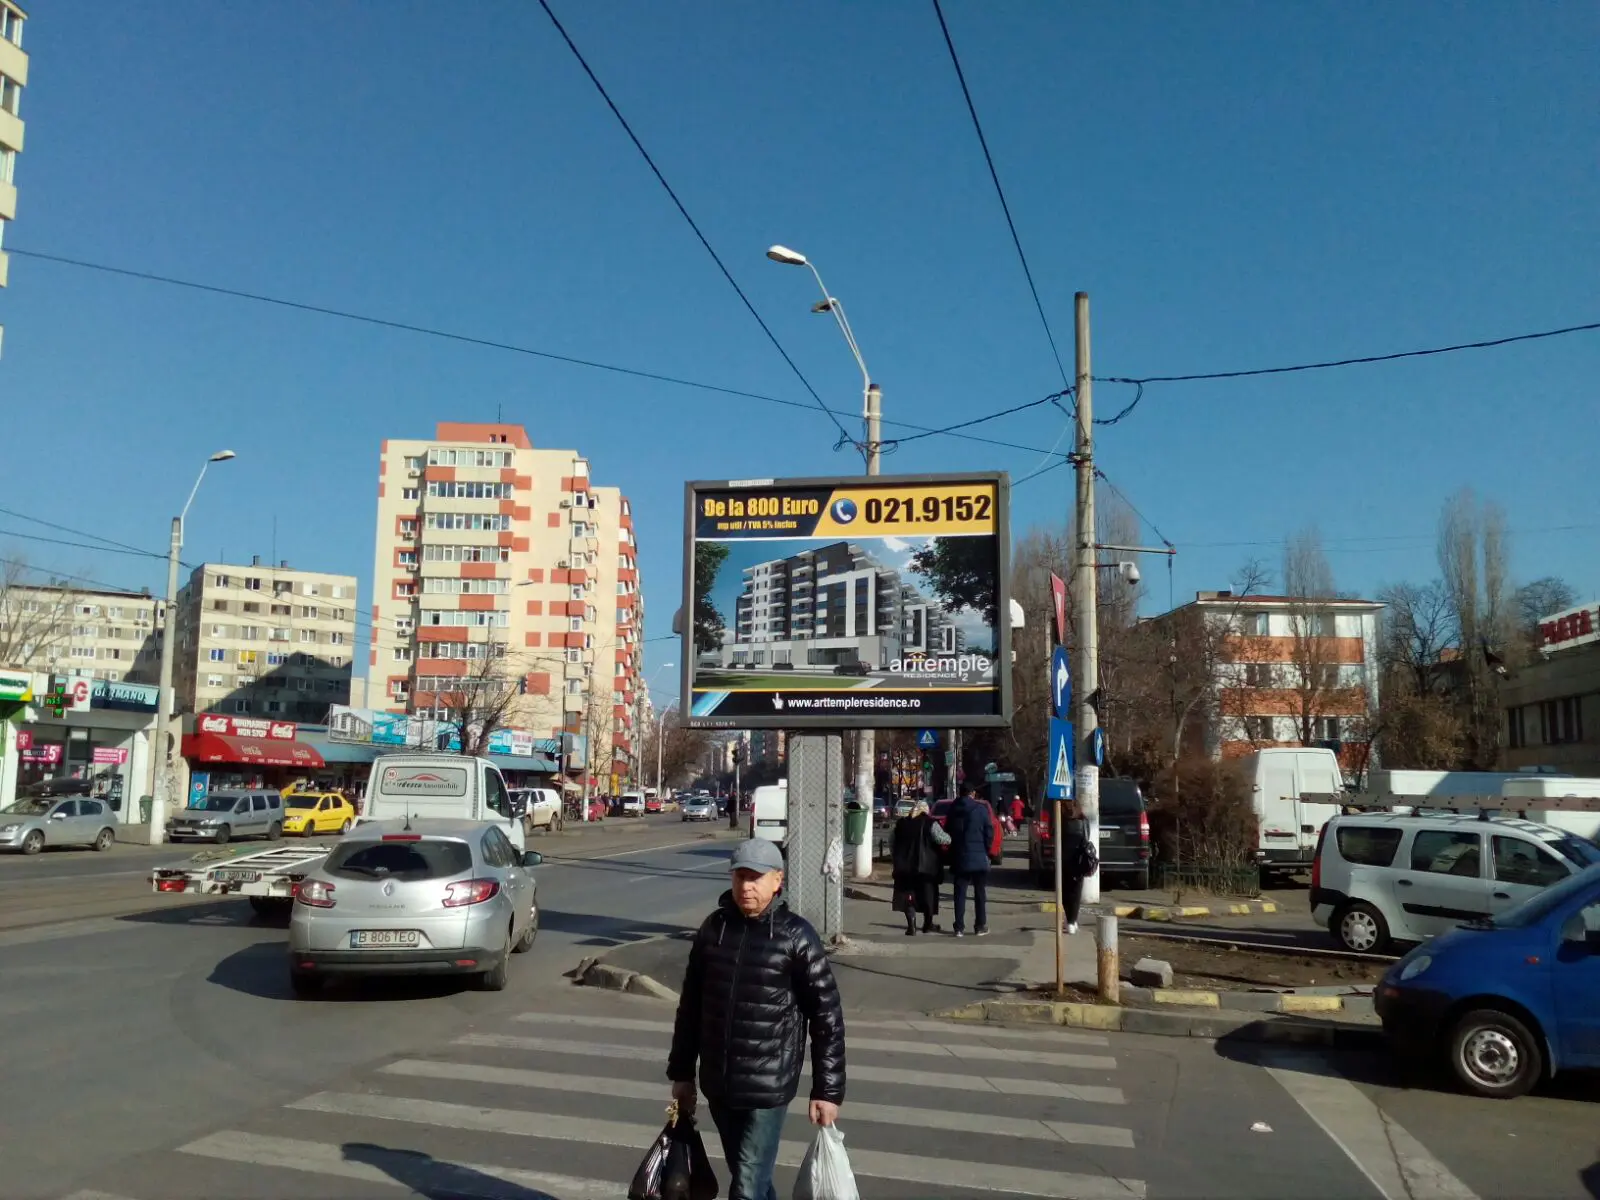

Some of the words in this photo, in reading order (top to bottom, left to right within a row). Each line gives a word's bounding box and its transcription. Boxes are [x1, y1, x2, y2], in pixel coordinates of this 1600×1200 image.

[704, 498, 726, 517] De
[728, 498, 745, 517] la
[747, 497, 779, 516] 800
[782, 496, 819, 516] Euro
[865, 494, 991, 524] 021.9152
[748, 520, 762, 530] TVA
[890, 652, 990, 677] arttemple
[961, 674, 969, 682] 2
[788, 697, 921, 709] www.arttempleresidence.ro
[359, 931, 367, 943] B
[371, 931, 391, 943] 806
[393, 931, 416, 943] TEO
